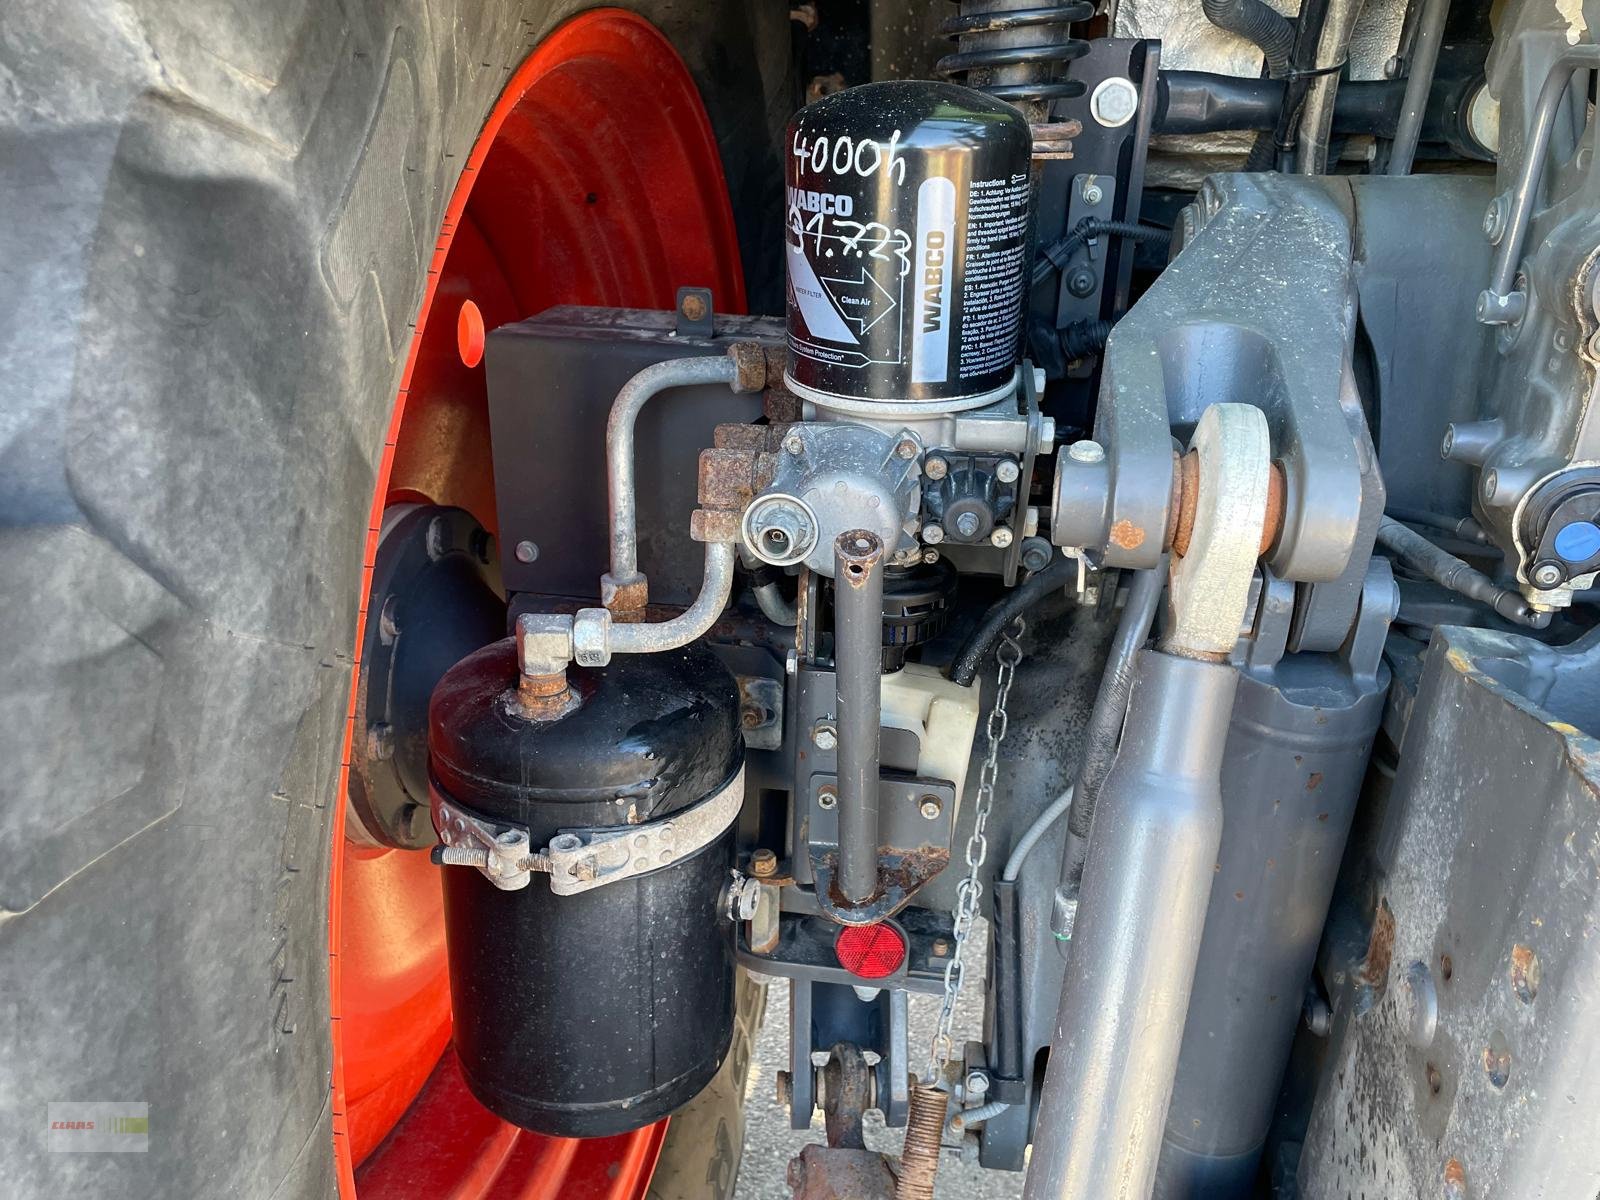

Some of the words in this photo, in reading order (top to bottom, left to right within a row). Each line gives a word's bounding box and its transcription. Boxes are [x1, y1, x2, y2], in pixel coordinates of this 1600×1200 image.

[793, 129, 905, 185] 4000h
[970, 179, 1006, 188] Instructions
[787, 185, 853, 217] WABCO
[922, 231, 945, 333] WABCO
[841, 296, 860, 304] Clean
